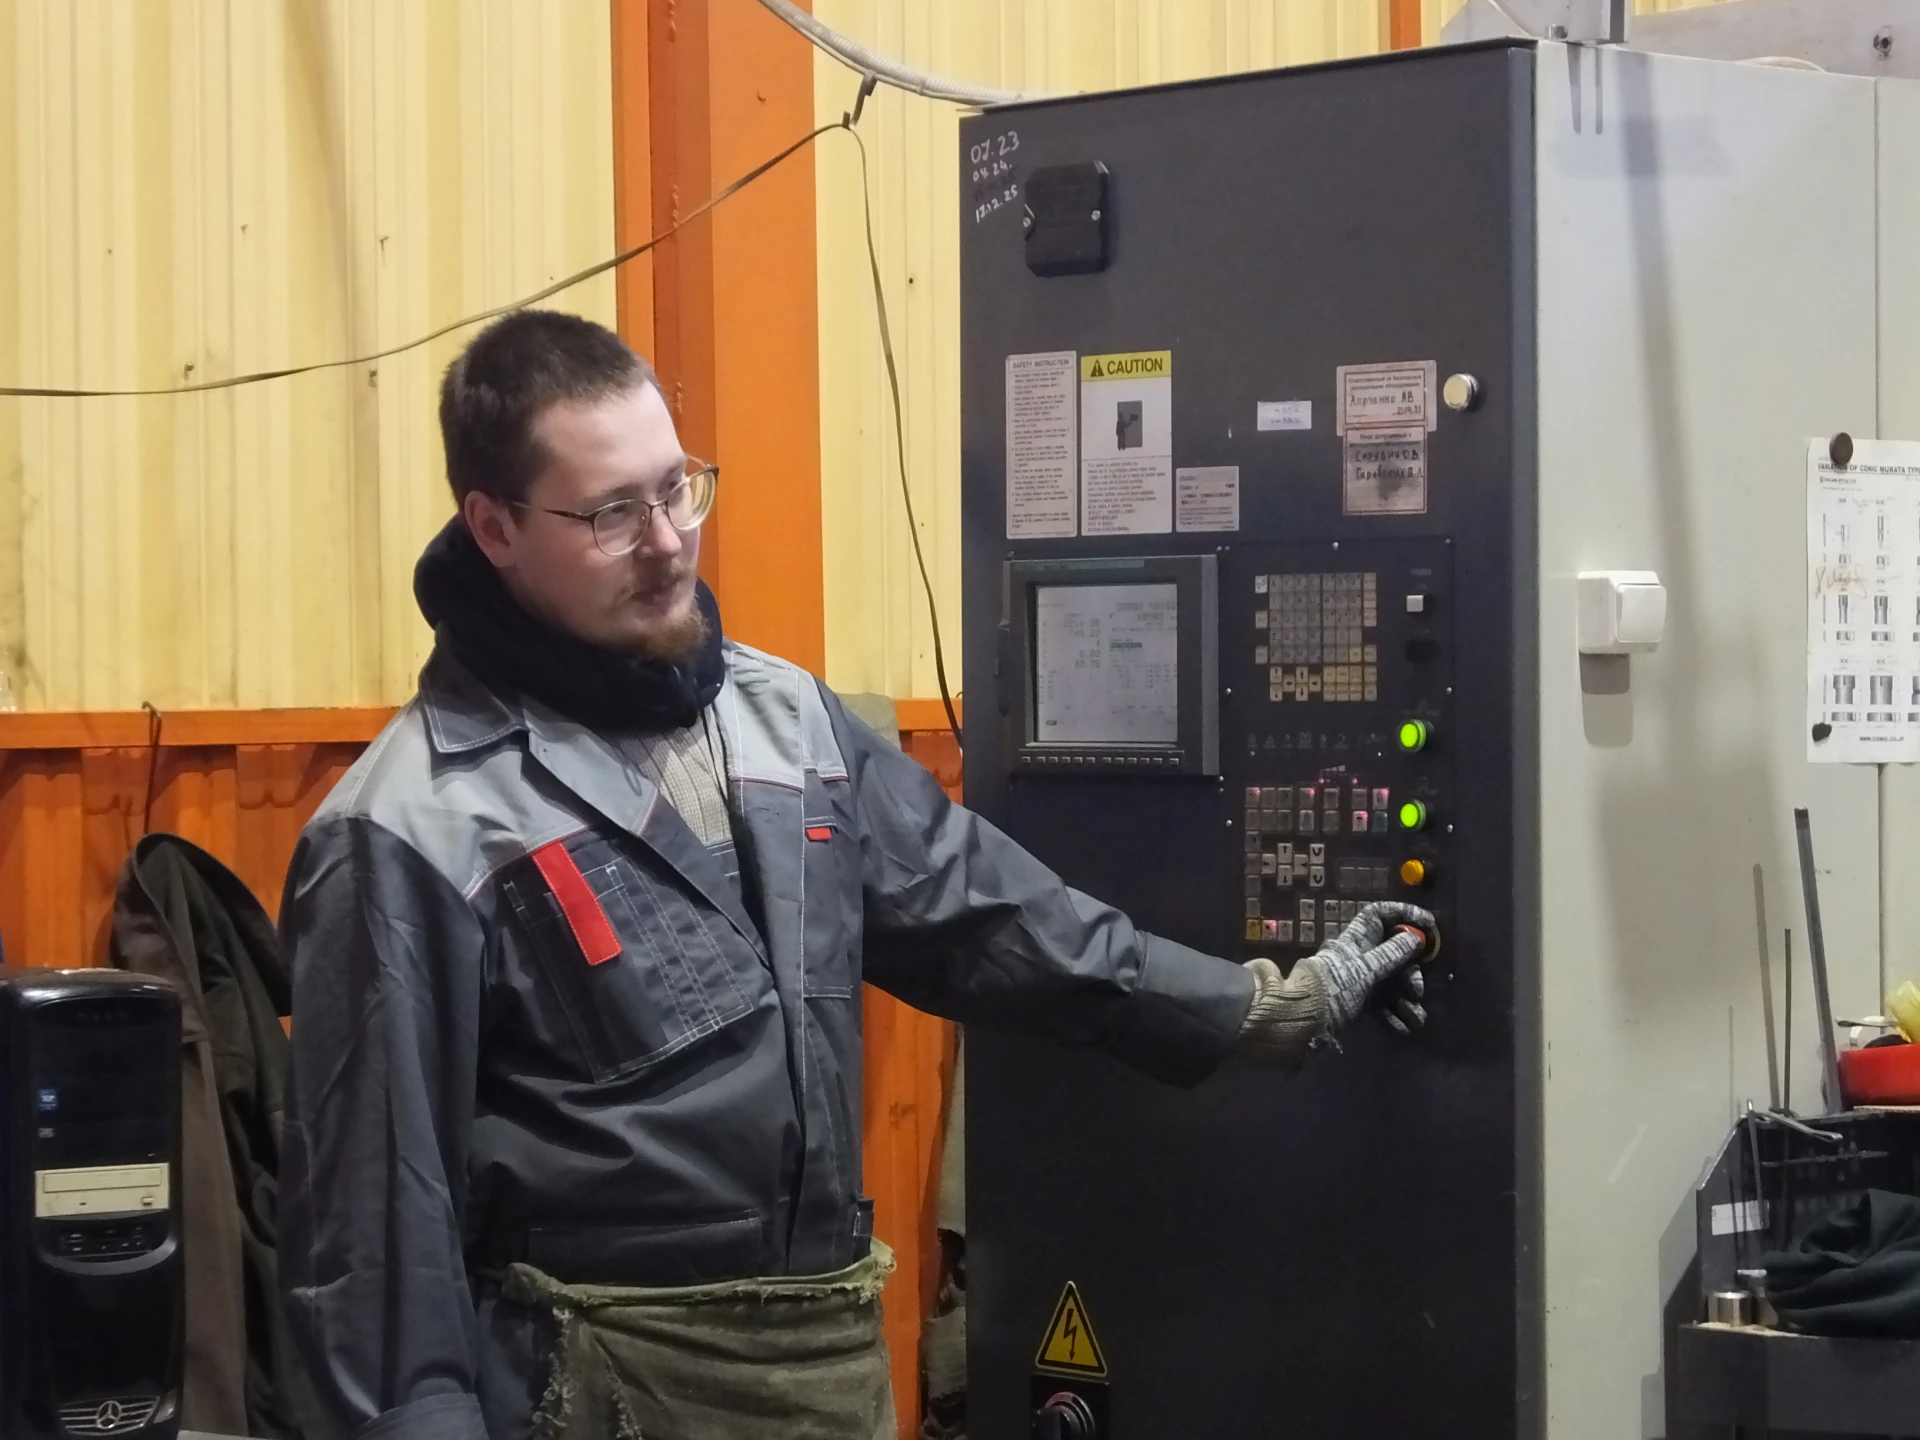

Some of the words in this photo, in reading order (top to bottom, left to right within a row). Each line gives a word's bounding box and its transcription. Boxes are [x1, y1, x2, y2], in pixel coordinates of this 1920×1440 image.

[1012, 361, 1033, 369] SAFETY
[1034, 358, 1070, 368] INSTRUCTION
[1106, 357, 1163, 375] CAUTION
[1859, 464, 1878, 473] CONIC
[1879, 465, 1906, 474] MURATA
